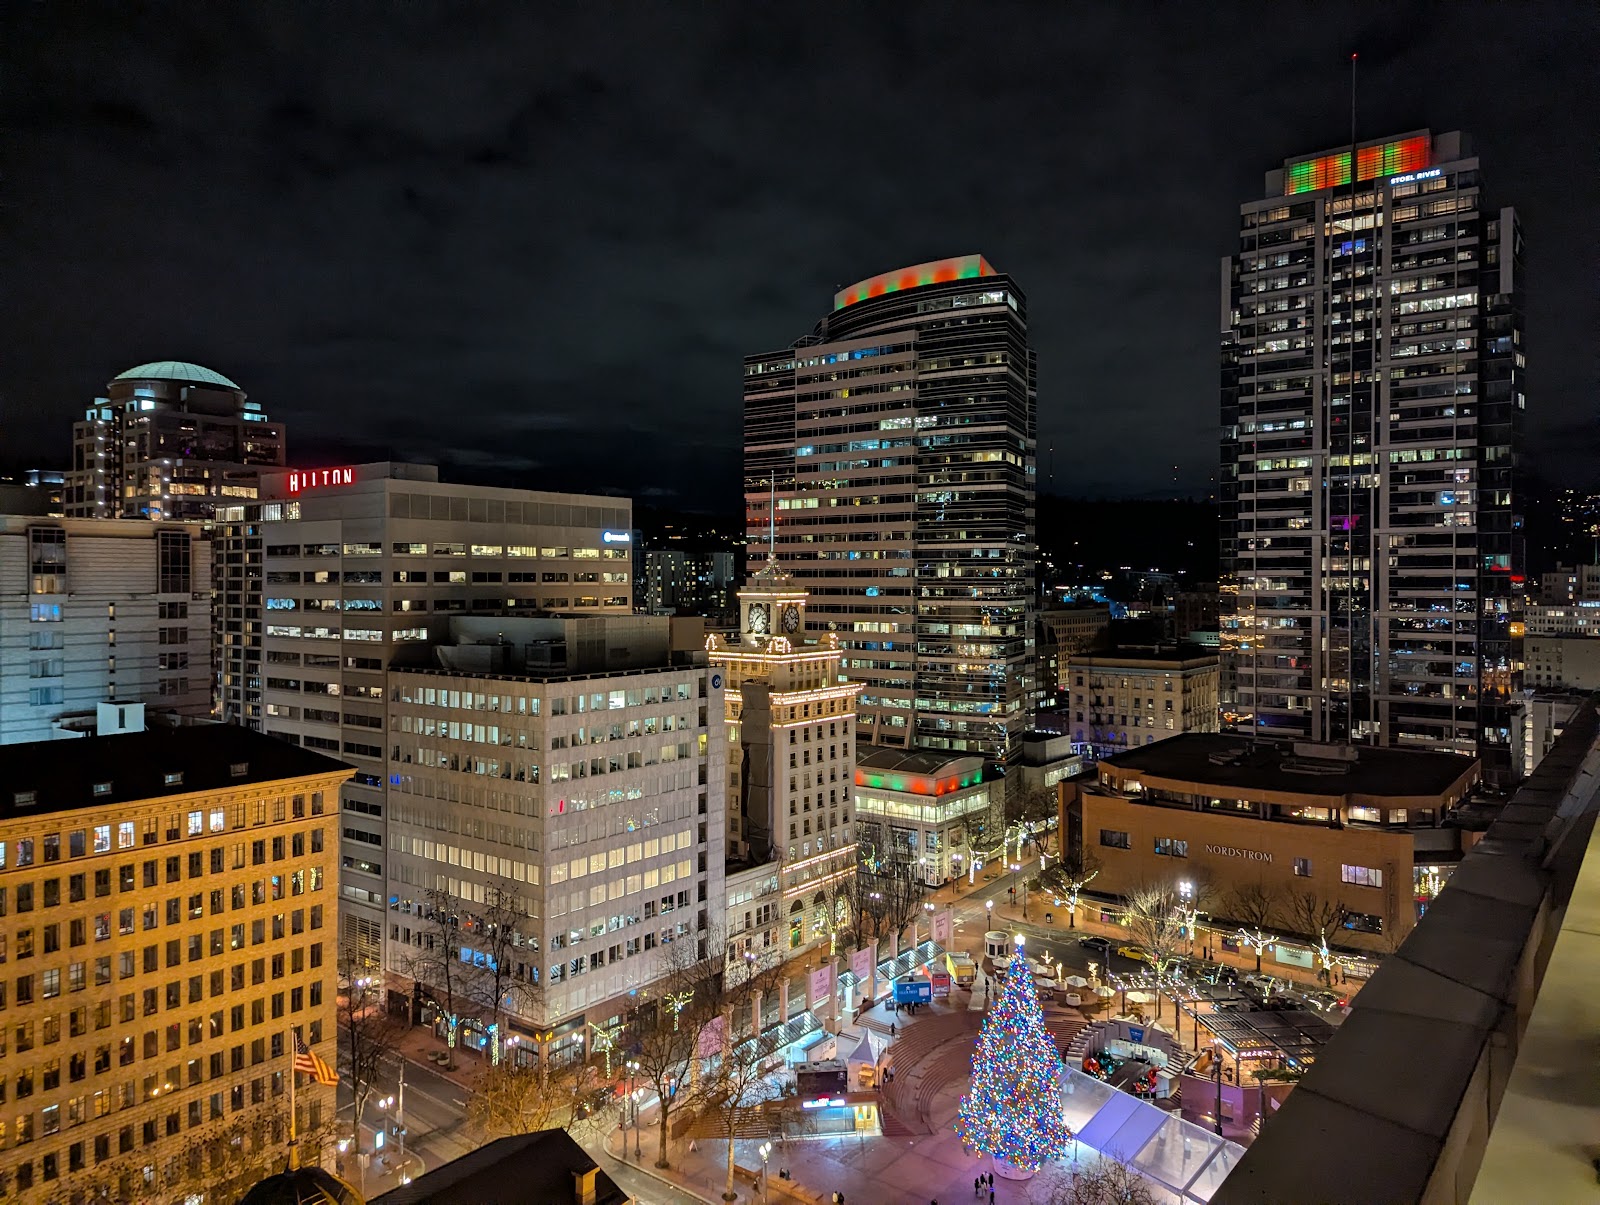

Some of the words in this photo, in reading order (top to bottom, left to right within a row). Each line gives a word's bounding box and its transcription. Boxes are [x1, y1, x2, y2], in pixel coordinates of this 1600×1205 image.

[1390, 174, 1415, 185] STOEL
[1416, 169, 1441, 179] RIVES
[289, 468, 352, 492] HILTON
[1205, 844, 1273, 863] NORDSTROM
